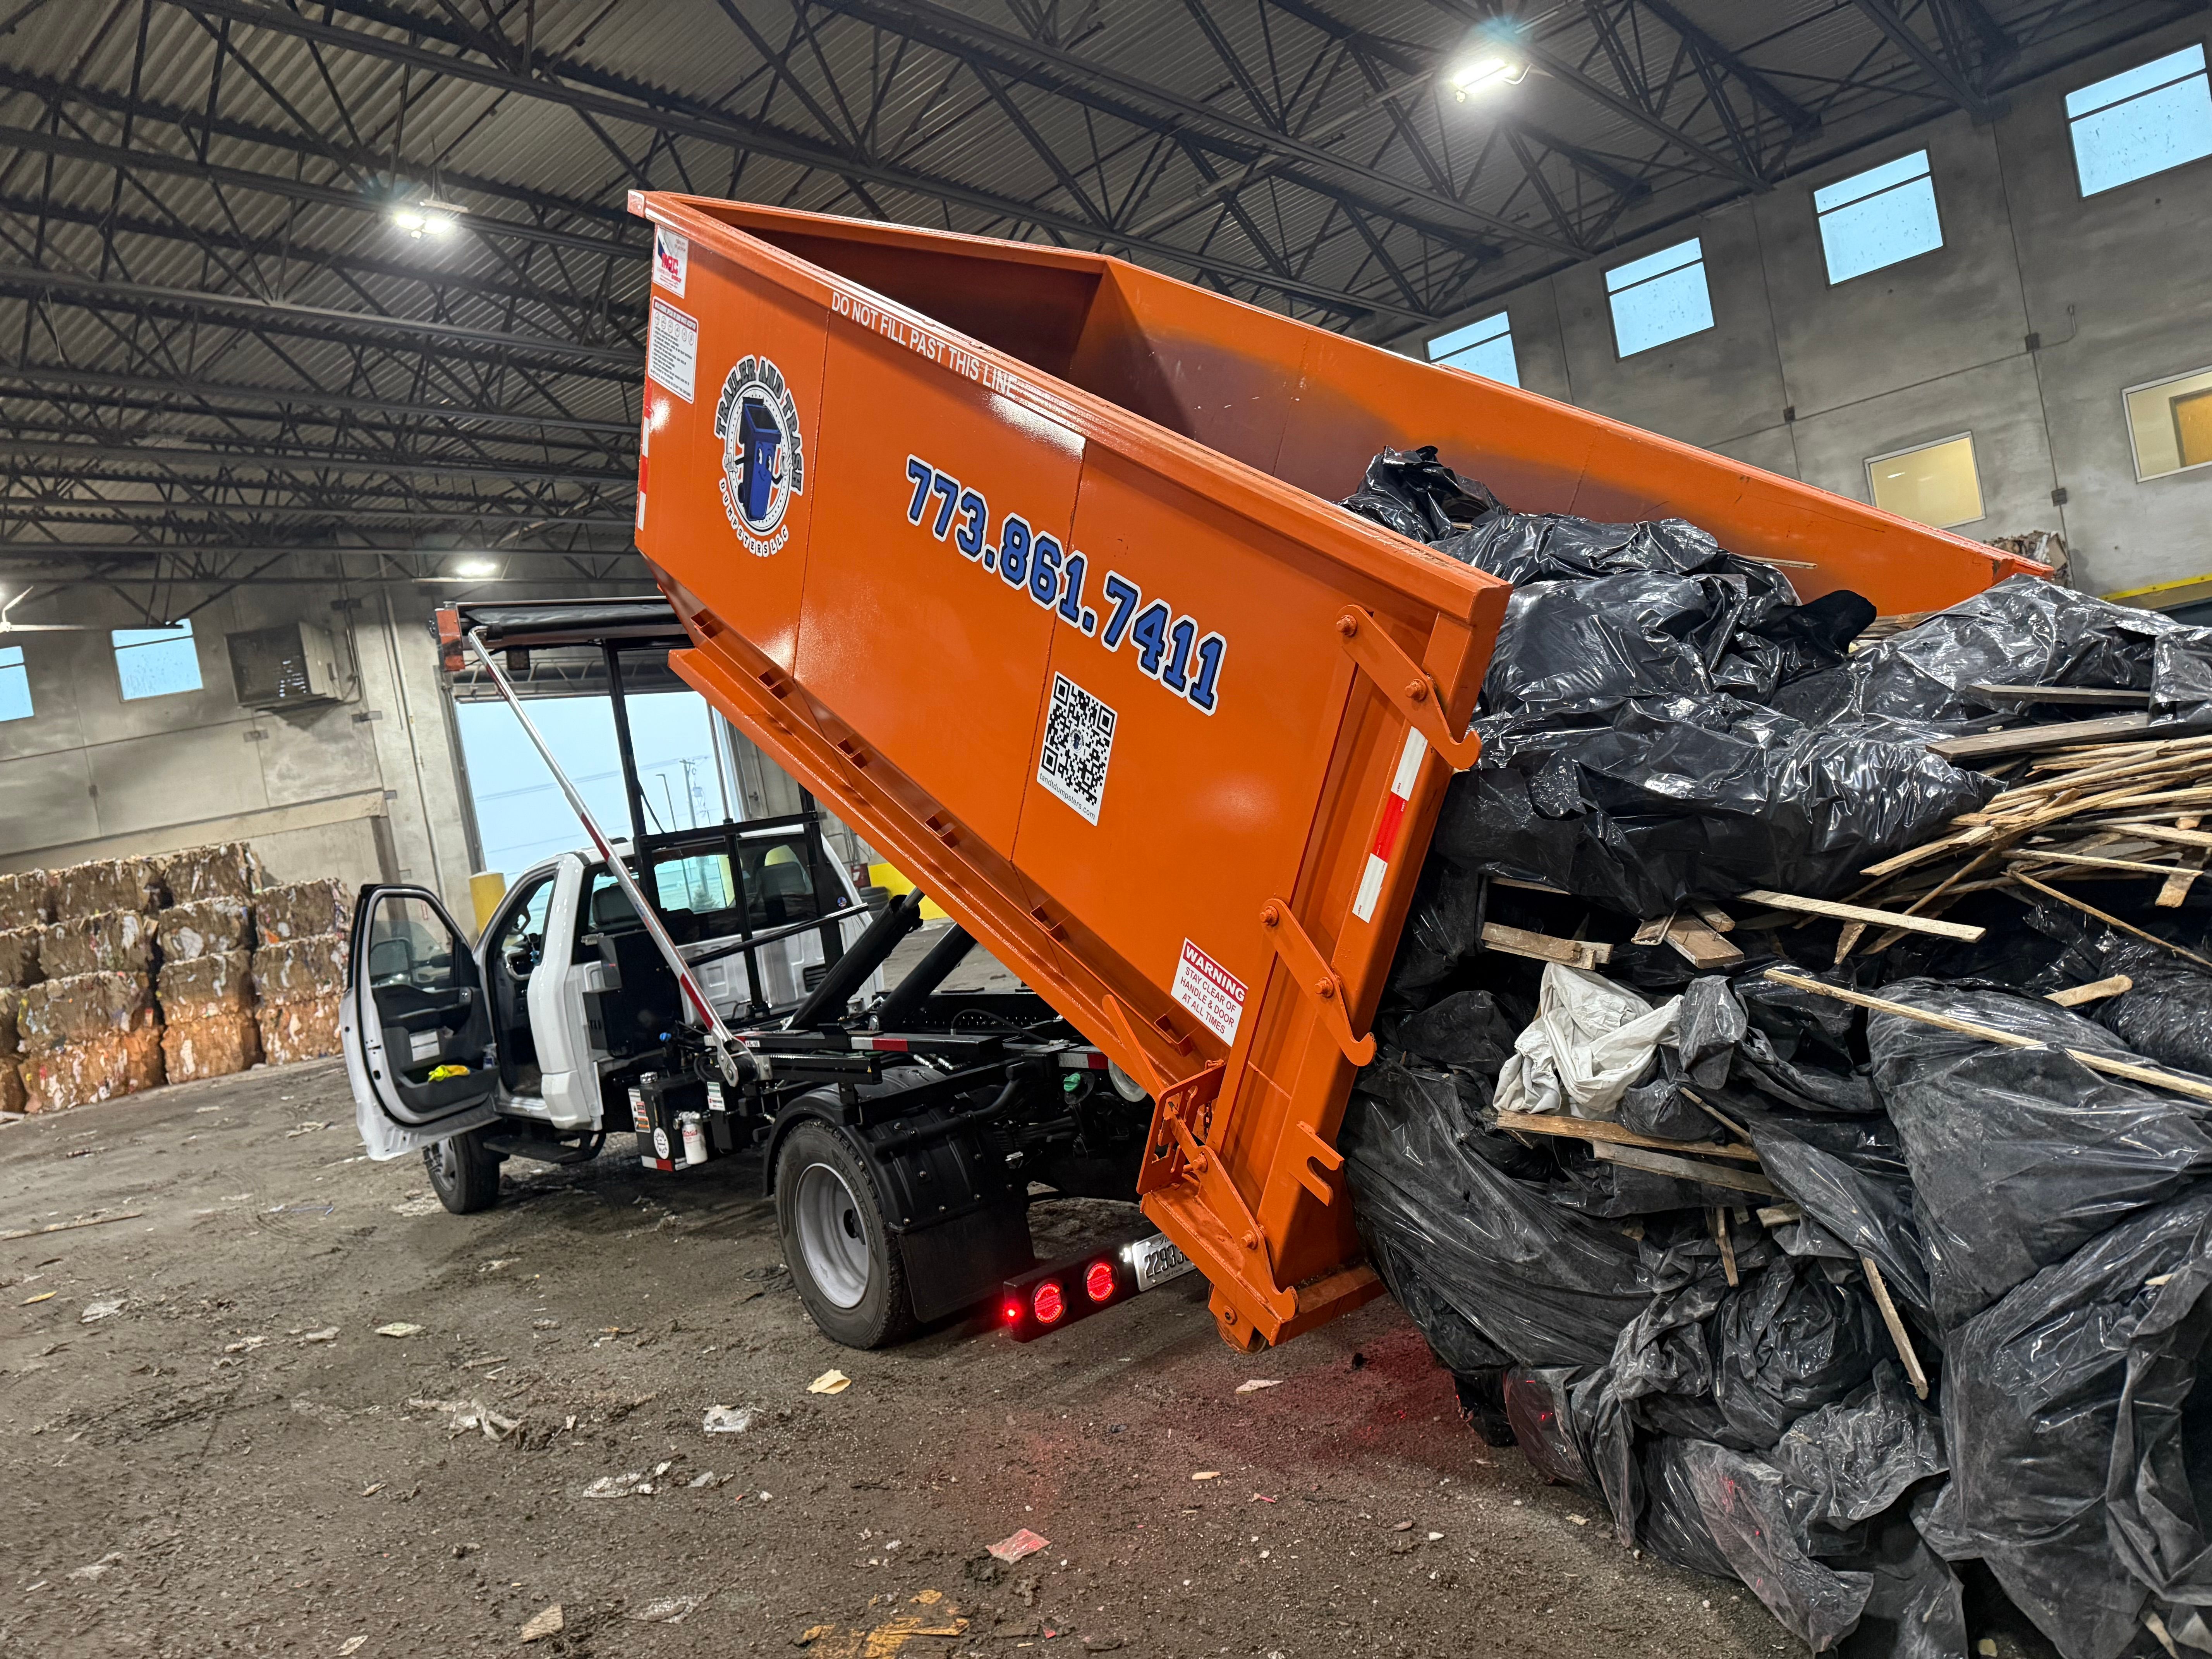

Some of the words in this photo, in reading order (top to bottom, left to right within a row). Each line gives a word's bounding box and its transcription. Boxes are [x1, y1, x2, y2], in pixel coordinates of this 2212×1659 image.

[832, 292, 850, 316] DO
[852, 301, 878, 330] NOT
[880, 315, 907, 346] FILL
[910, 329, 945, 362] PAST
[949, 347, 979, 381] THIS
[983, 365, 1017, 398] LINE
[716, 358, 756, 436] TRAILER
[758, 359, 783, 399] AND
[783, 395, 803, 491] TRASH
[720, 481, 768, 554] DUMPSTERS
[771, 529, 788, 551] LLC
[907, 455, 1226, 715] 773.861.7411
[1040, 773, 1095, 820] tandtdumpsters.com
[1180, 976, 1207, 1004] HANDLE
[1207, 1000, 1212, 1009] &
[1214, 1005, 1234, 1027] DOOR
[1185, 967, 1202, 983] STAY
[1202, 981, 1224, 1005] CLEAR
[1226, 1001, 1236, 1012] OF
[1186, 945, 1245, 1002] WARNING
[1182, 993, 1191, 1004] AT
[1191, 1001, 1203, 1017] ALL
[1206, 1011, 1226, 1034] TIMES
